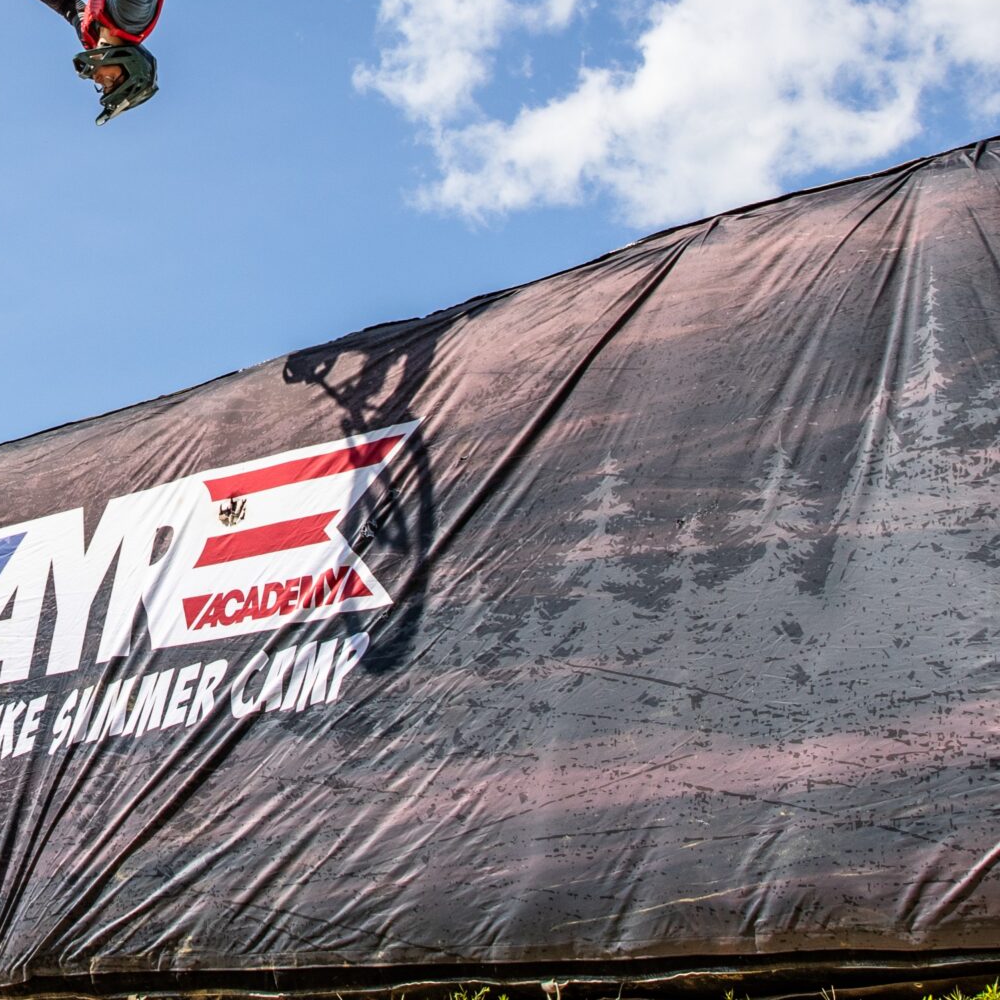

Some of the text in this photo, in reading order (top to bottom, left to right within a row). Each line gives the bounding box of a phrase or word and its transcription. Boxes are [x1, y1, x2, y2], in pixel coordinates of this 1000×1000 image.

[192, 565, 352, 631] ACADEMY
[48, 659, 228, 756] SUMMER
[230, 631, 370, 719] CAMP
